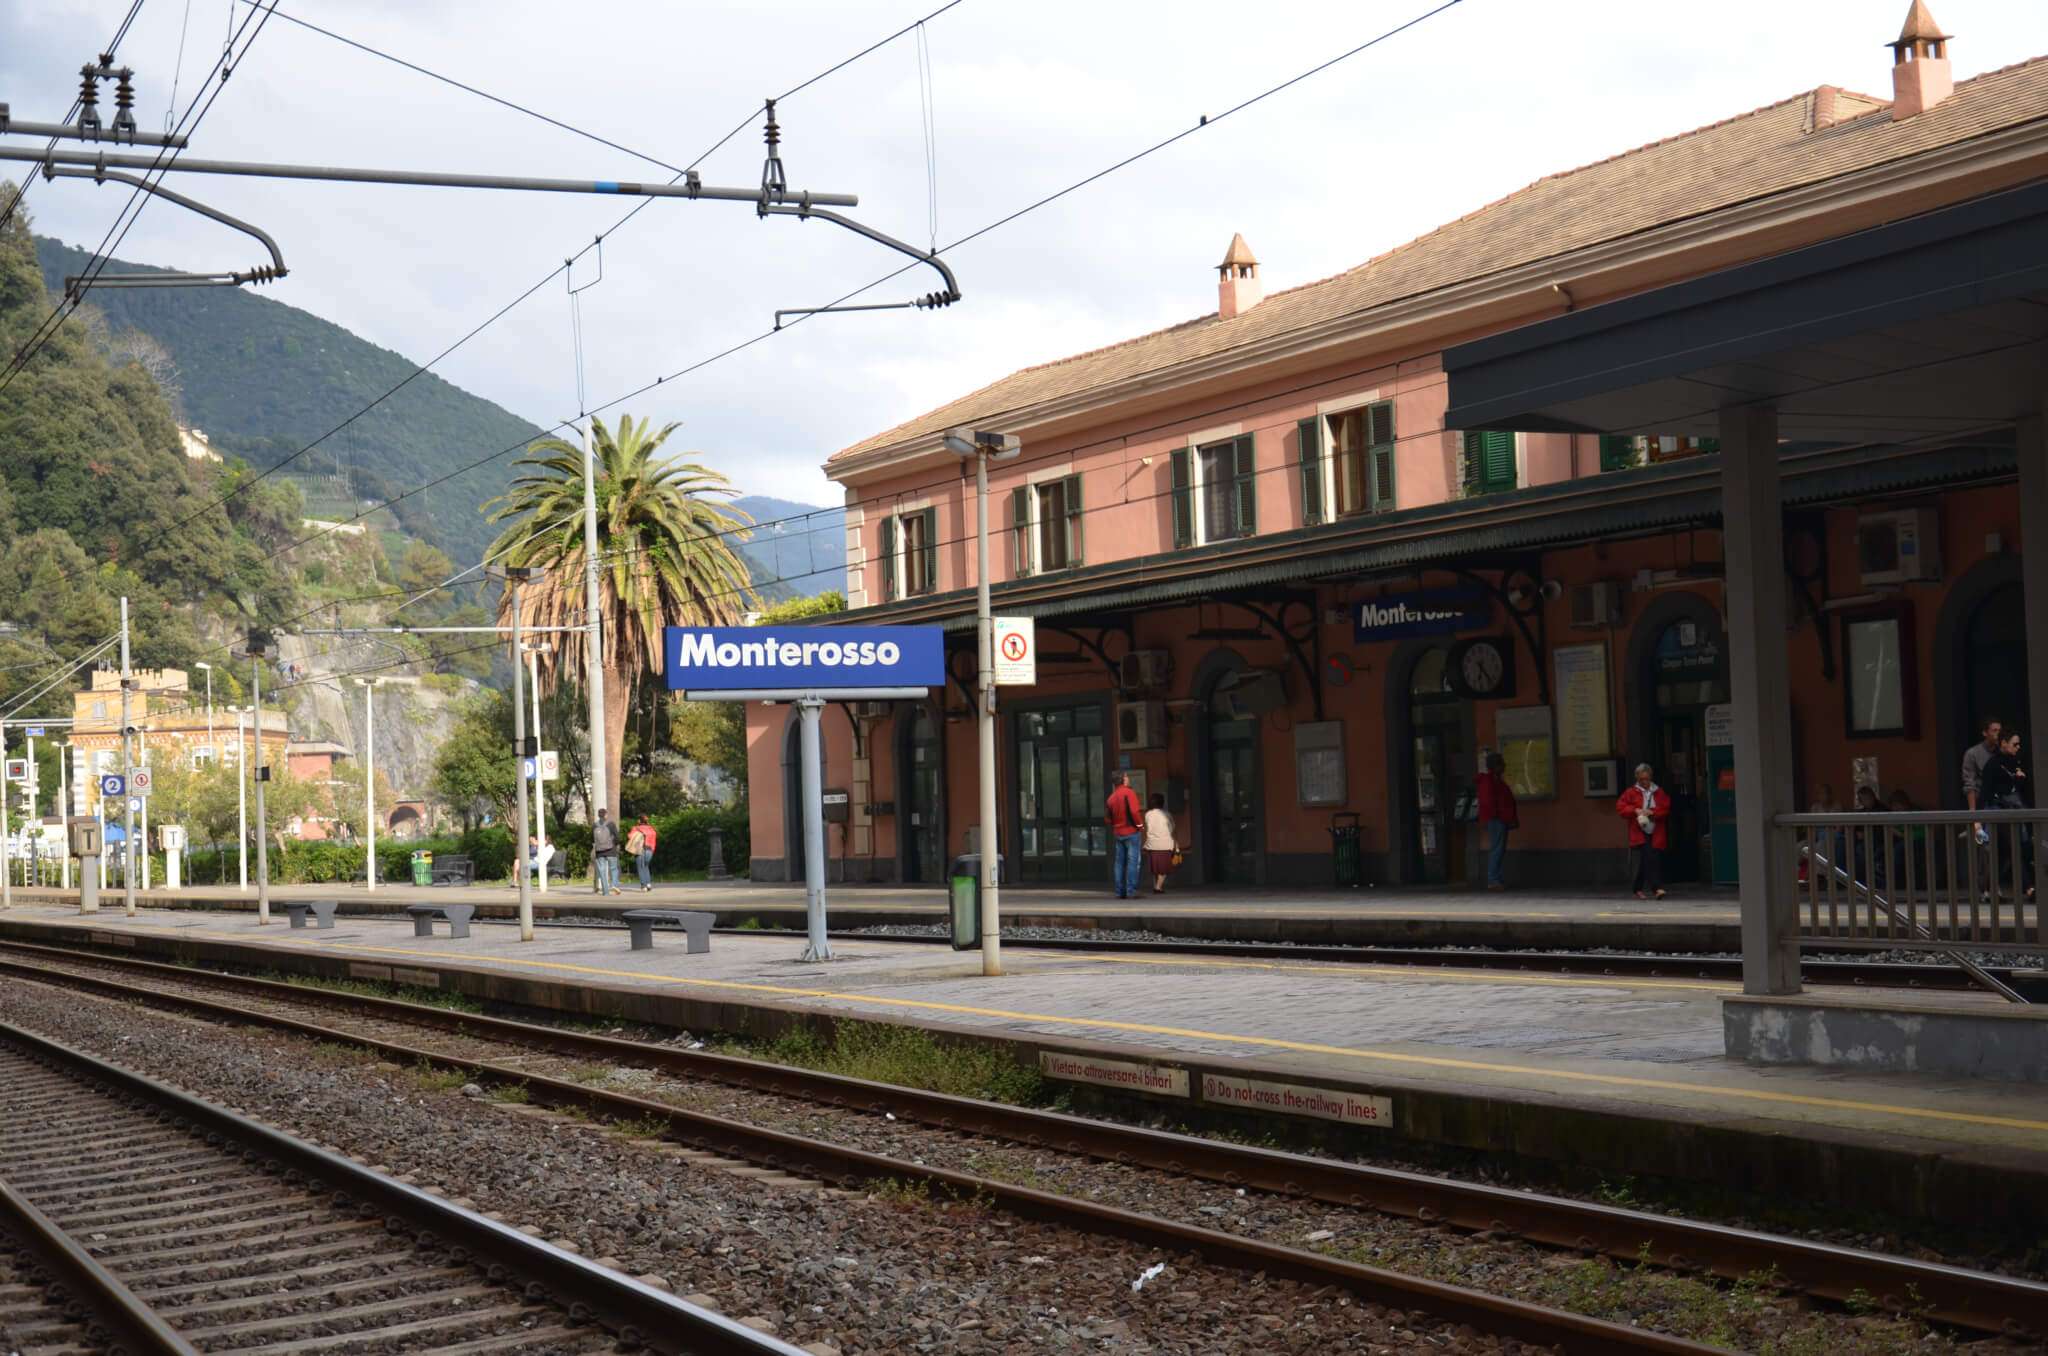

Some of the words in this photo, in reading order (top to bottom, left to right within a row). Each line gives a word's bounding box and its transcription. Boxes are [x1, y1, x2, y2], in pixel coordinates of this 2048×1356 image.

[679, 633, 900, 667] Monterosso
[108, 780, 118, 791] 2
[83, 829, 94, 850] T
[169, 831, 178, 846] T
[1051, 1058, 1082, 1076] Vietato
[1145, 1070, 1172, 1088] binari
[1218, 1082, 1232, 1098] Do
[1235, 1087, 1252, 1101] not
[1256, 1090, 1281, 1105] cross
[1283, 1090, 1303, 1107] the
[1305, 1094, 1344, 1117] railway
[1347, 1099, 1377, 1119] lines
